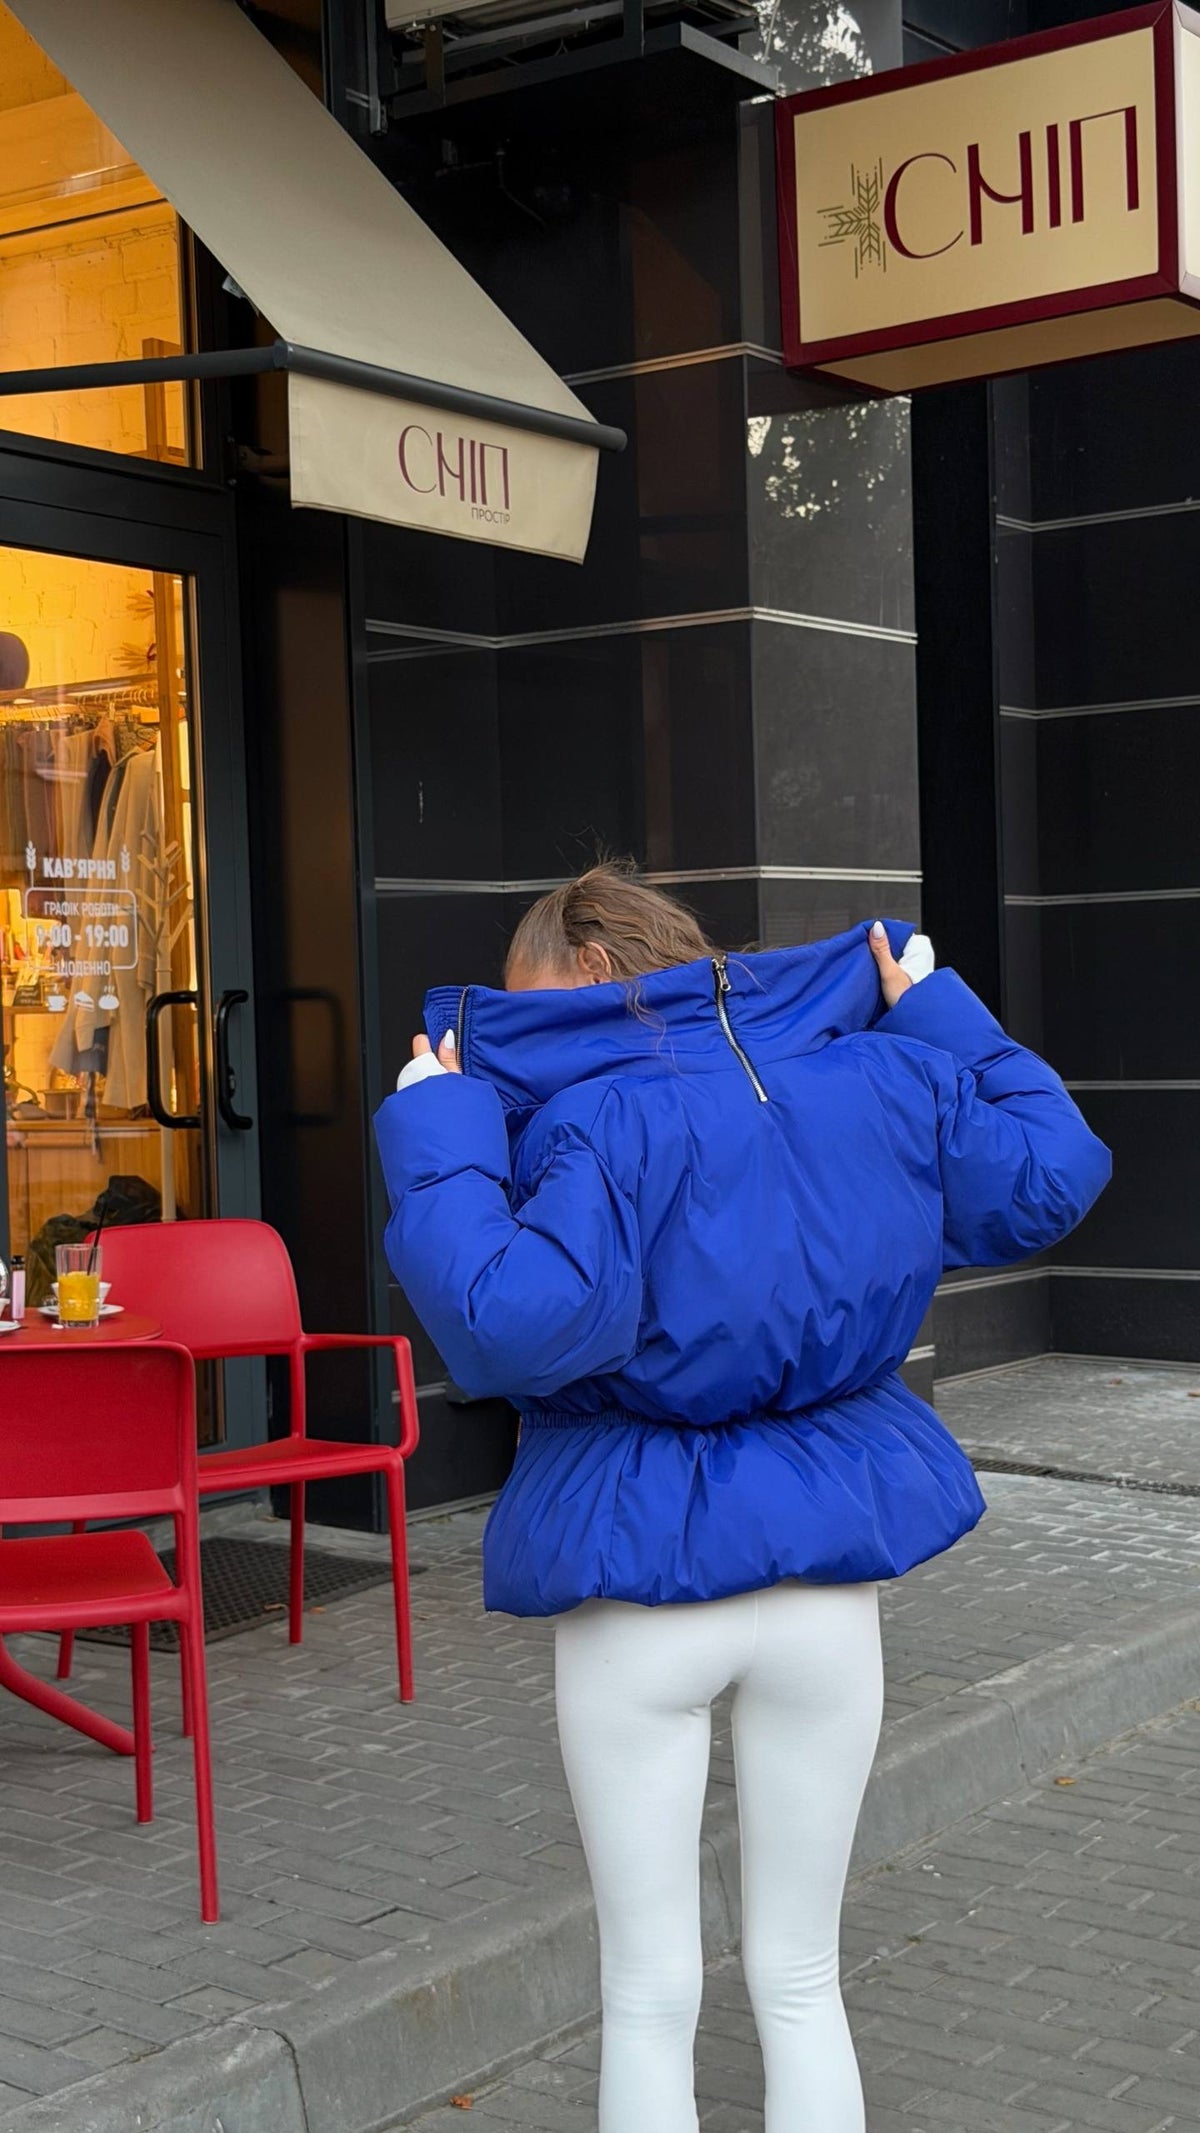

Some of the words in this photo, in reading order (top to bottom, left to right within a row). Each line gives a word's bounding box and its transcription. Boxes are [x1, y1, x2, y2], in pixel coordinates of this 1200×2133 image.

[884, 106, 1140, 259] СНІП
[398, 424, 510, 510] СНІП
[44, 901, 80, 916] ГРАФІК
[85, 924, 129, 948] 19:00
[55, 960, 111, 978] ЩОДЕННО
